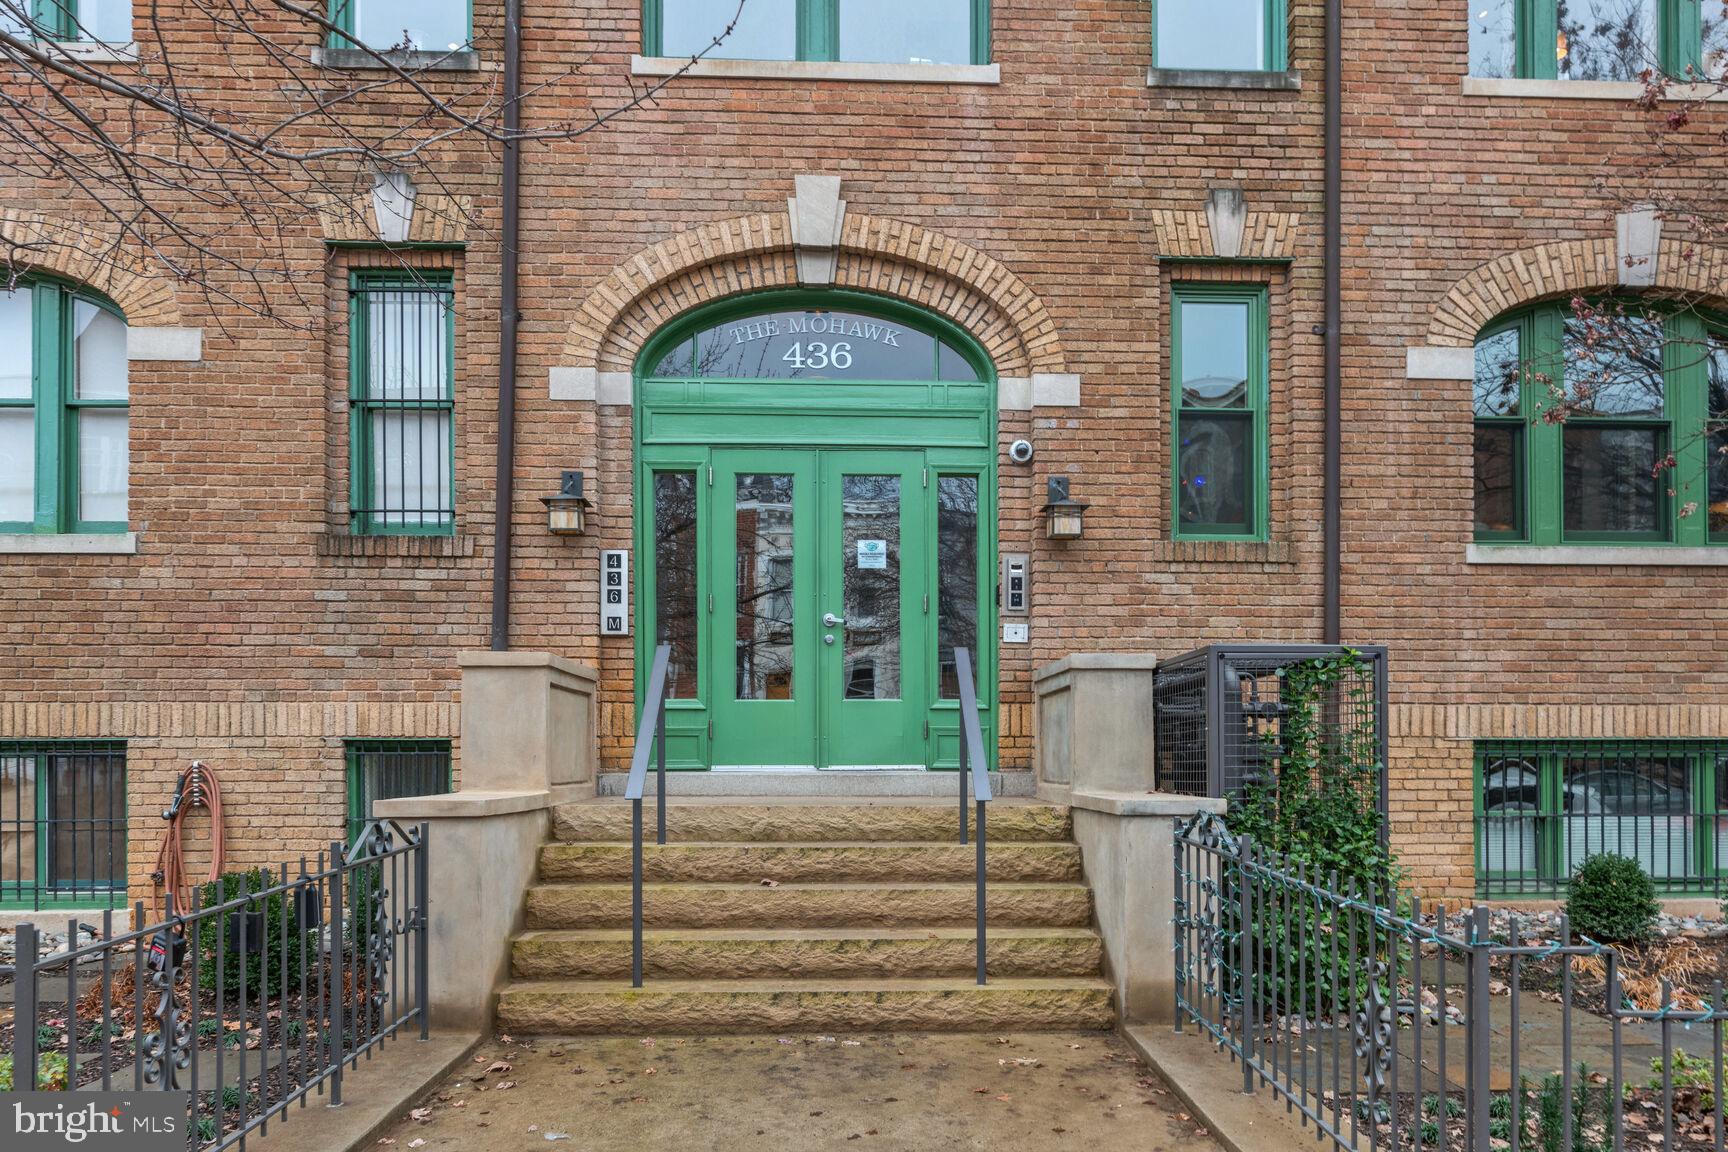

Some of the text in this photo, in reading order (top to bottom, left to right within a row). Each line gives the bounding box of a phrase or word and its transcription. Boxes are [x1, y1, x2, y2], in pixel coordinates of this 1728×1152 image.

[729, 317, 902, 348] THE MOHAWK
[782, 342, 852, 369] 436
[608, 618, 620, 629] M
